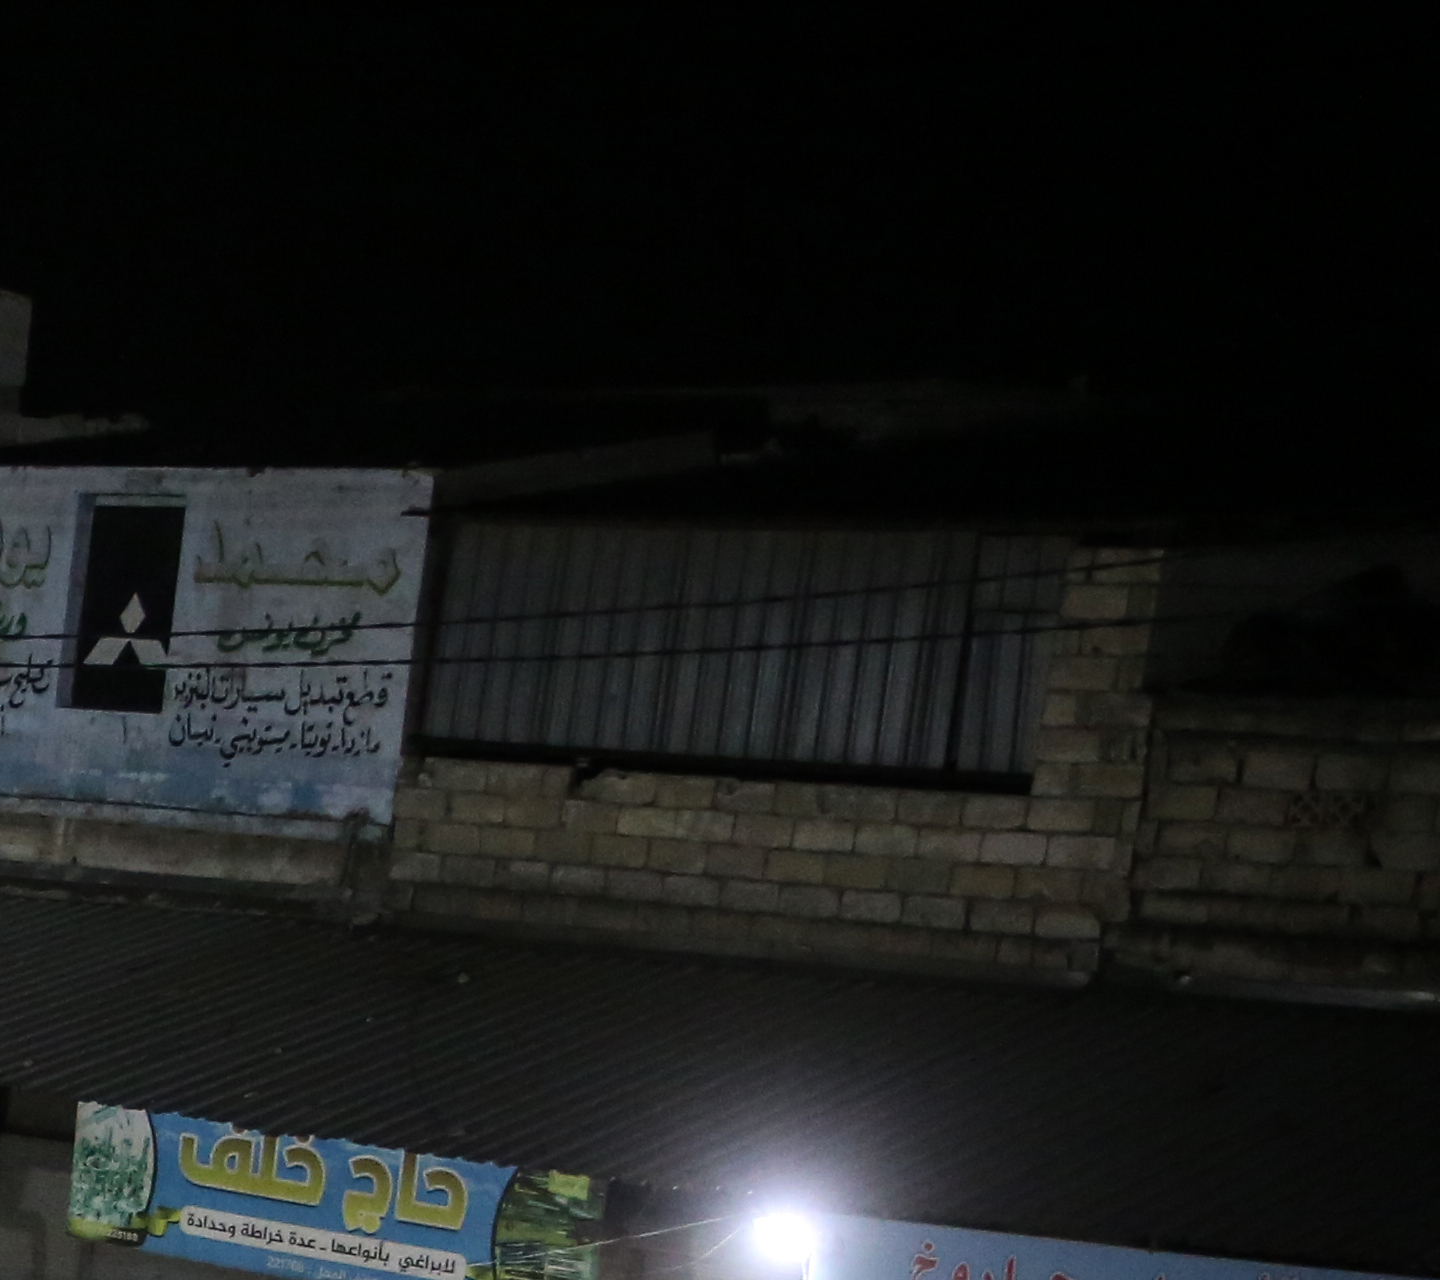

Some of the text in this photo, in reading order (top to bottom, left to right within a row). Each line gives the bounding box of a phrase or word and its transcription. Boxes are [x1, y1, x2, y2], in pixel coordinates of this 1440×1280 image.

[342, 1148, 469, 1234] حاج
[185, 1210, 237, 1239] وحدادة
[239, 1222, 285, 1249] خراطة
[286, 1232, 315, 1252] عدة
[330, 1236, 391, 1266] بأنواعها
